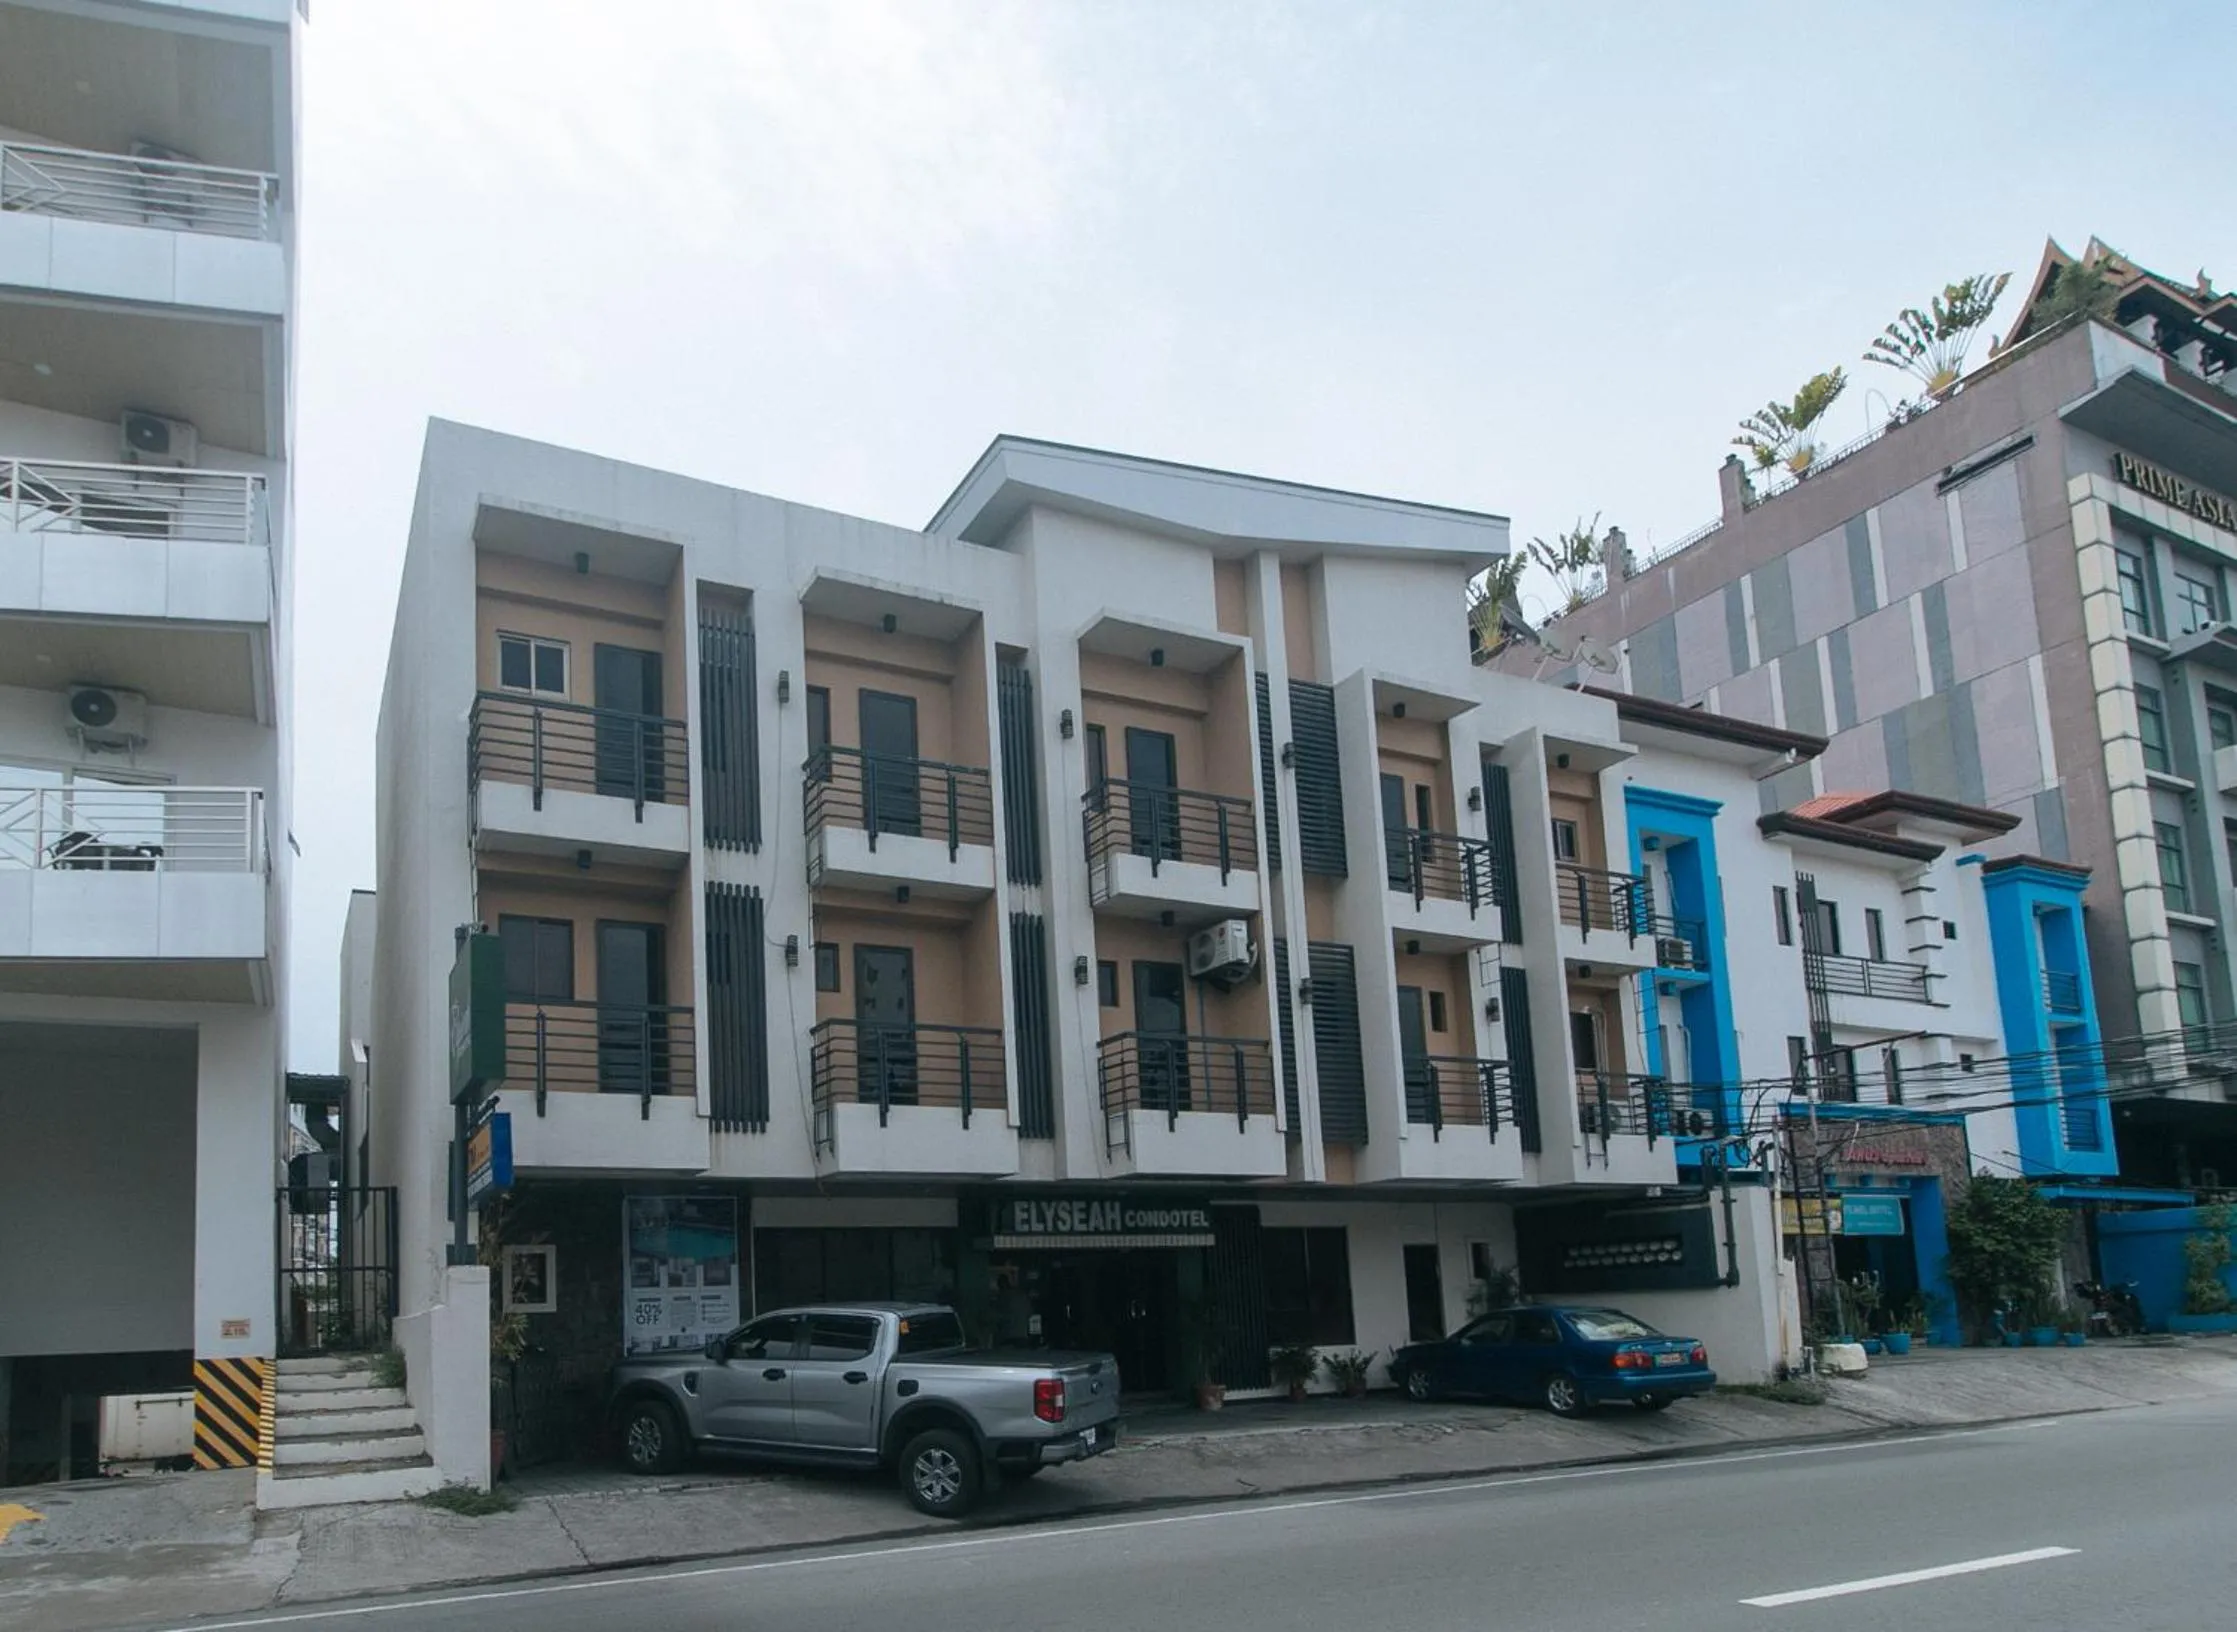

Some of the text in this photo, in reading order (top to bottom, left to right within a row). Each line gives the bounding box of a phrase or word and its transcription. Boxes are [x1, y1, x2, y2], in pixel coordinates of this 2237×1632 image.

[2119, 452, 2237, 528] PRIME ASIA
[1013, 1200, 1210, 1232] ELYSEAH CONDOTEL
[635, 1303, 662, 1315] 40%
[635, 1314, 660, 1326] OFF
